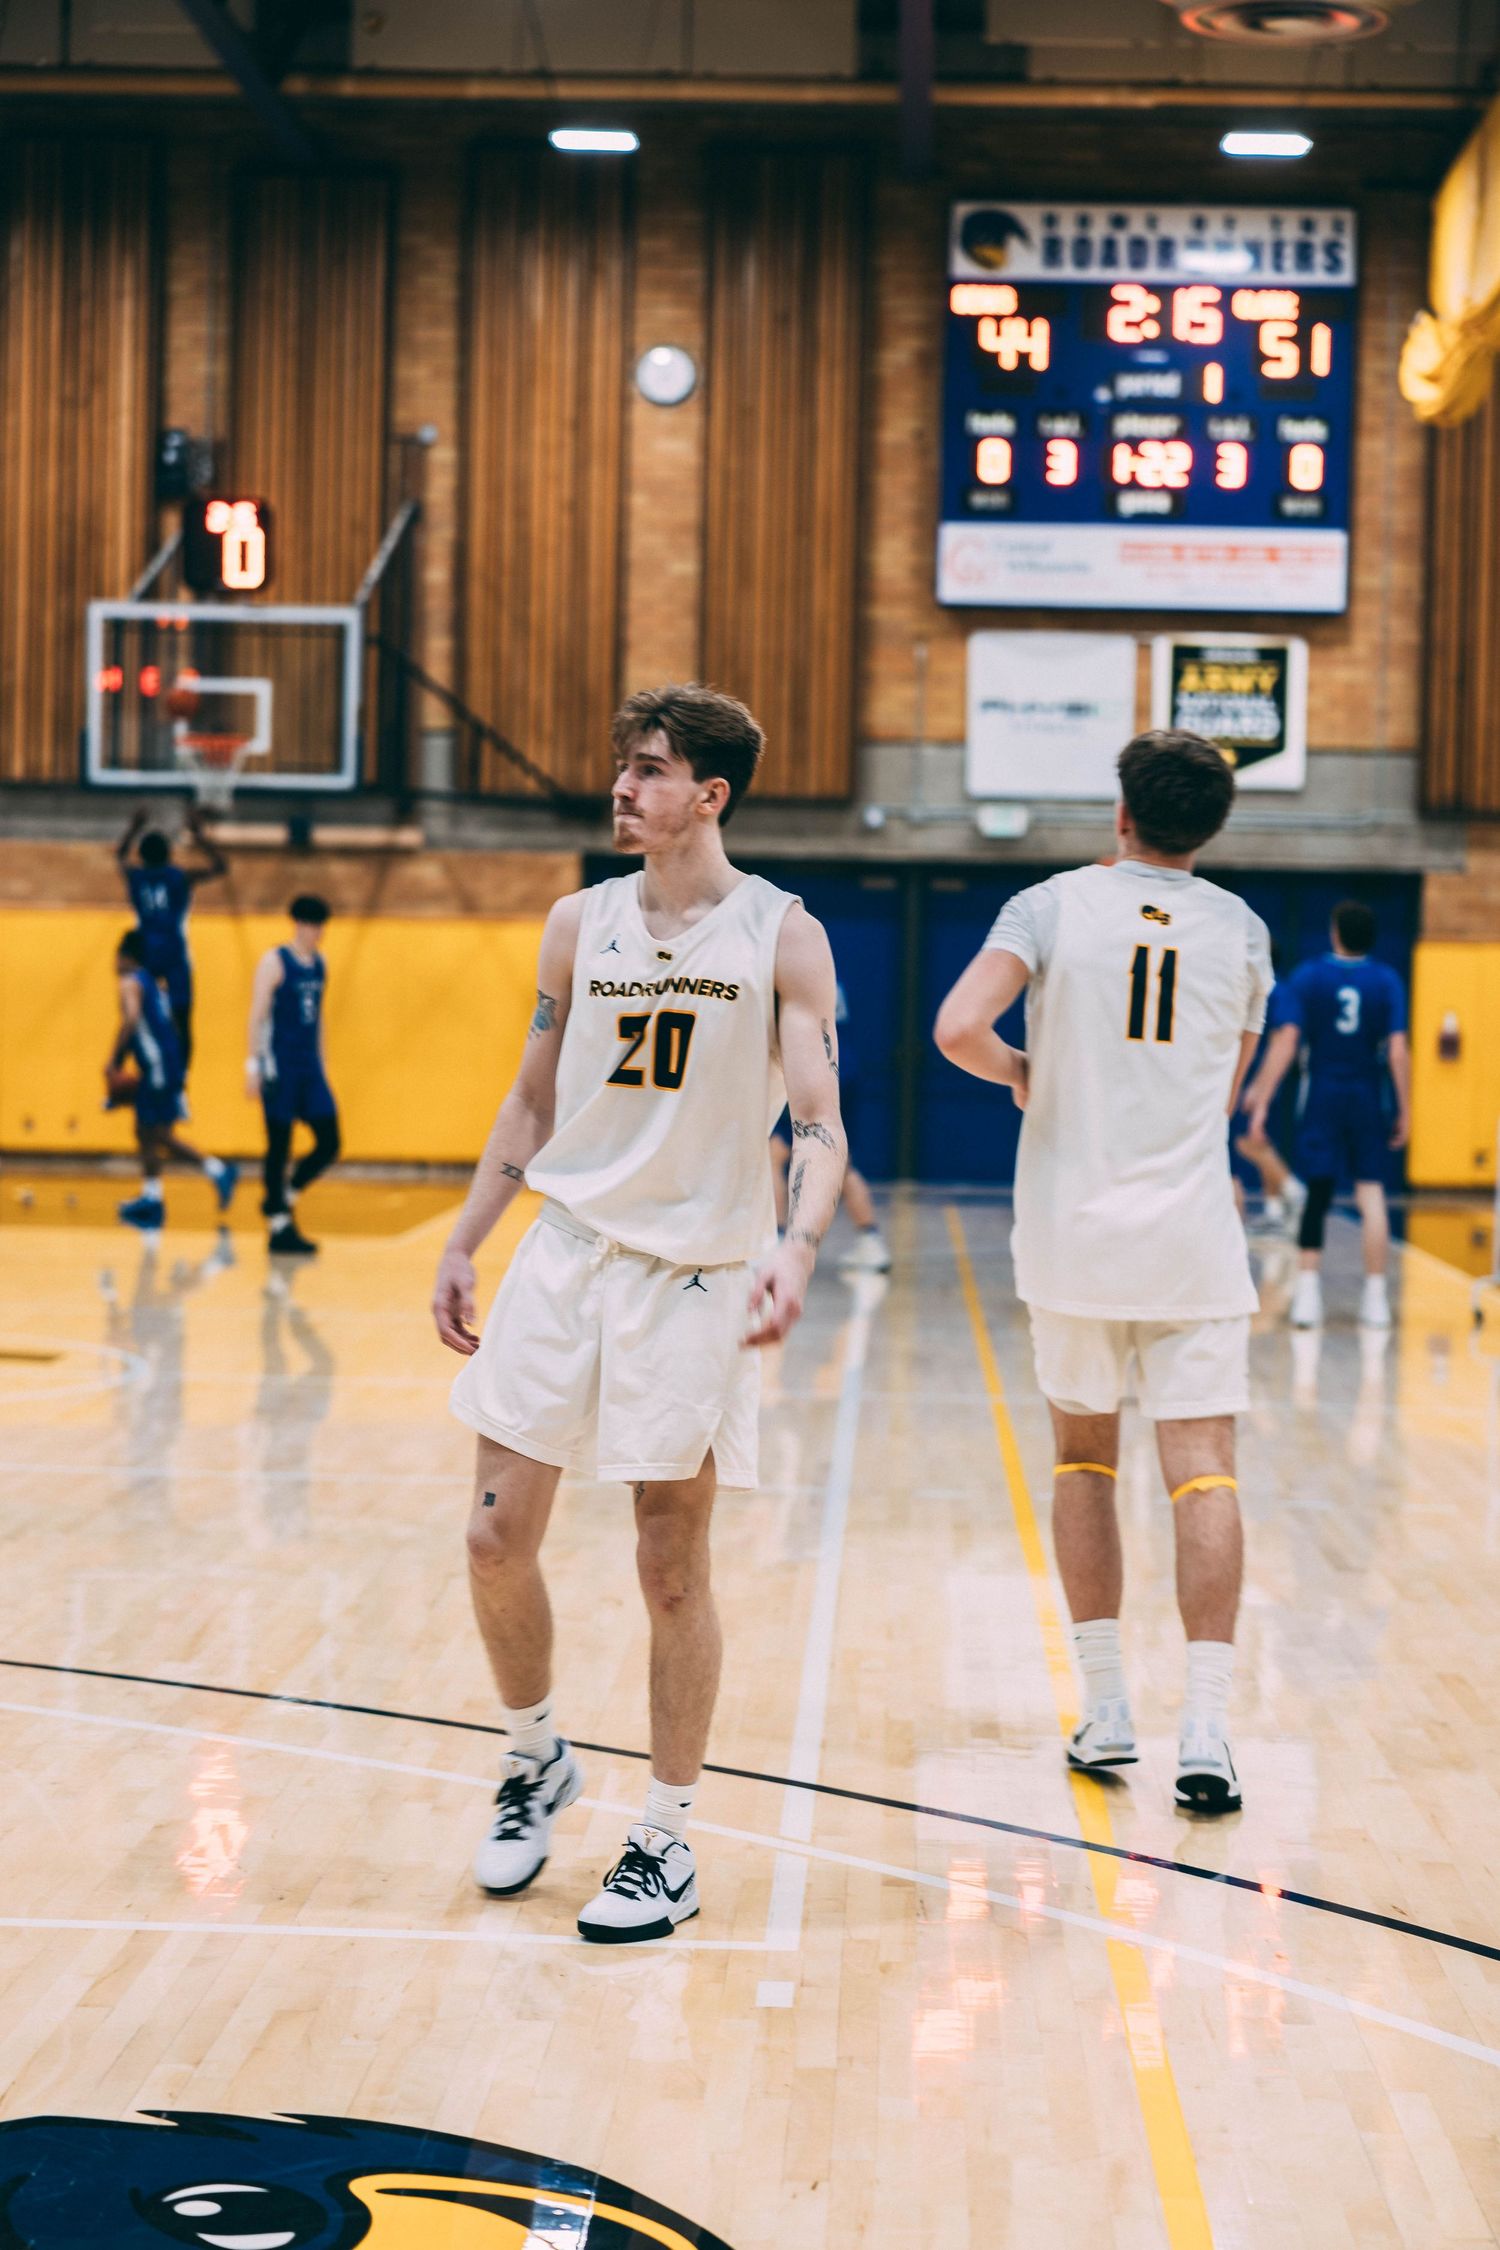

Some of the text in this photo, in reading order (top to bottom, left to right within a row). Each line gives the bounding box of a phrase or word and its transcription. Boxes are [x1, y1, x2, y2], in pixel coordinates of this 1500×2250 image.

[1043, 235, 1343, 275] ROADRNERS
[978, 316, 1050, 372] 44
[1259, 320, 1332, 378] 51
[1203, 361, 1224, 405] 1
[976, 437, 1012, 485] 0
[1045, 438, 1080, 487] 3
[1215, 441, 1248, 491] 3
[1288, 442, 1325, 492] 0
[222, 526, 266, 590] 0
[589, 976, 740, 1001] ROADRUNNERS
[1127, 944, 1178, 1043] 11
[1336, 985, 1361, 1035] 3
[605, 1009, 698, 1092] 20
